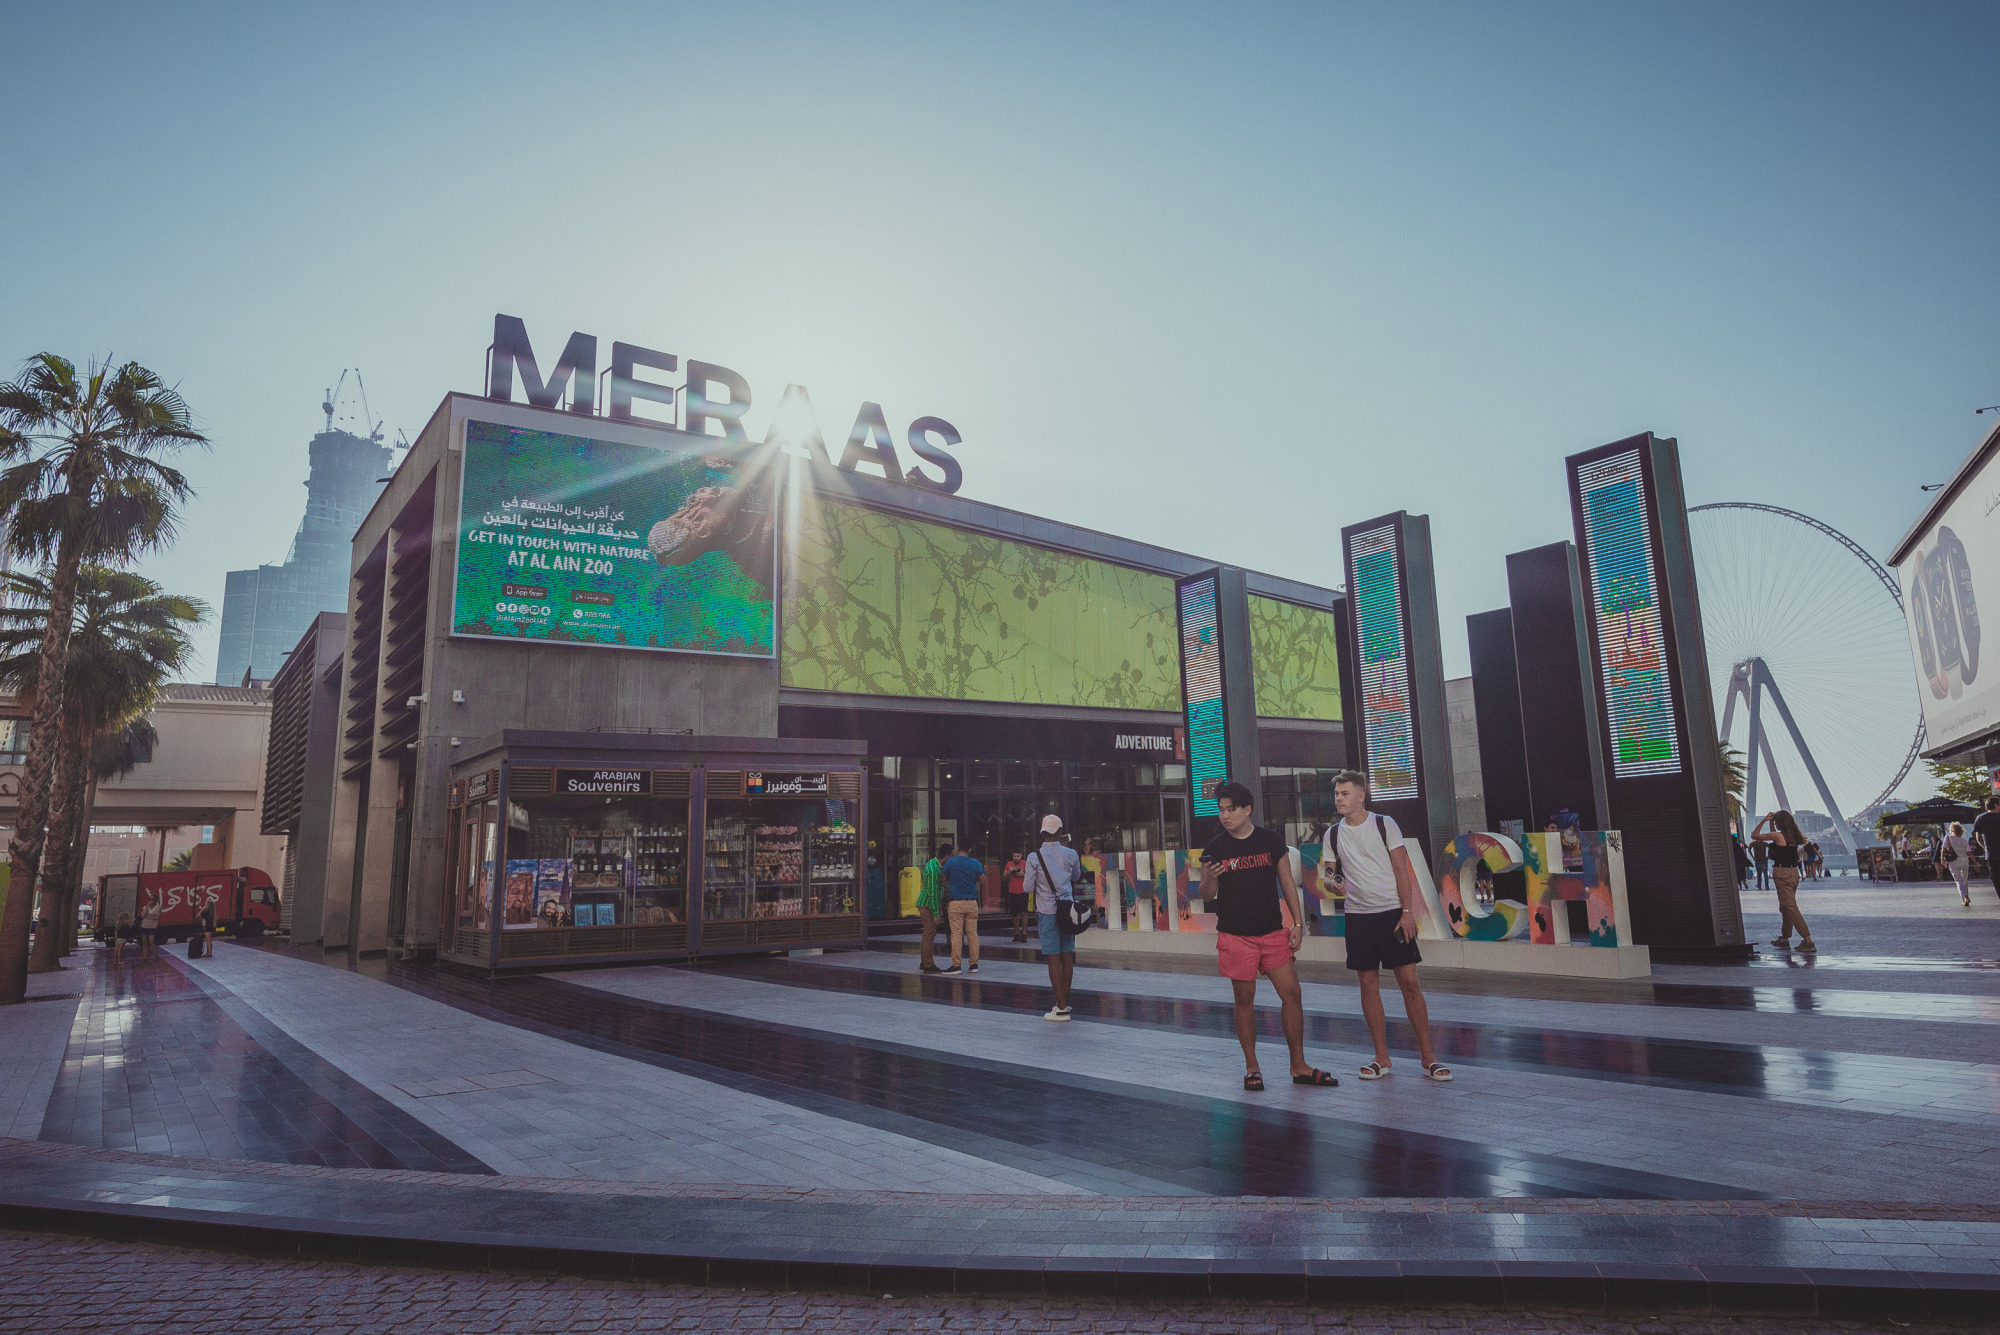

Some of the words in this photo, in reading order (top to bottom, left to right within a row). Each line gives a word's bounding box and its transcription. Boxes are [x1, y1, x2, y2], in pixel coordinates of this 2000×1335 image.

[490, 313, 963, 495] MERAAS
[502, 495, 519, 511] في
[521, 499, 563, 514] الطبيعة
[483, 511, 528, 528] بالعين
[565, 506, 582, 520] إلى
[583, 506, 609, 519] أقرب
[610, 511, 625, 522] كن
[531, 516, 596, 535] الحيوانات
[597, 522, 639, 540] حديقة
[468, 529, 496, 544] GET
[498, 532, 514, 546] IN
[517, 535, 560, 551] TOUCH
[563, 540, 597, 555] WITH
[600, 545, 651, 561] NATURE
[508, 550, 529, 567] AT
[530, 552, 551, 570] AL
[552, 555, 581, 572] AIN
[583, 558, 613, 576] ZOO
[1115, 734, 1173, 751] ADVENTURE
[593, 771, 641, 780] ARABIAN
[567, 779, 641, 792] Souvenirs
